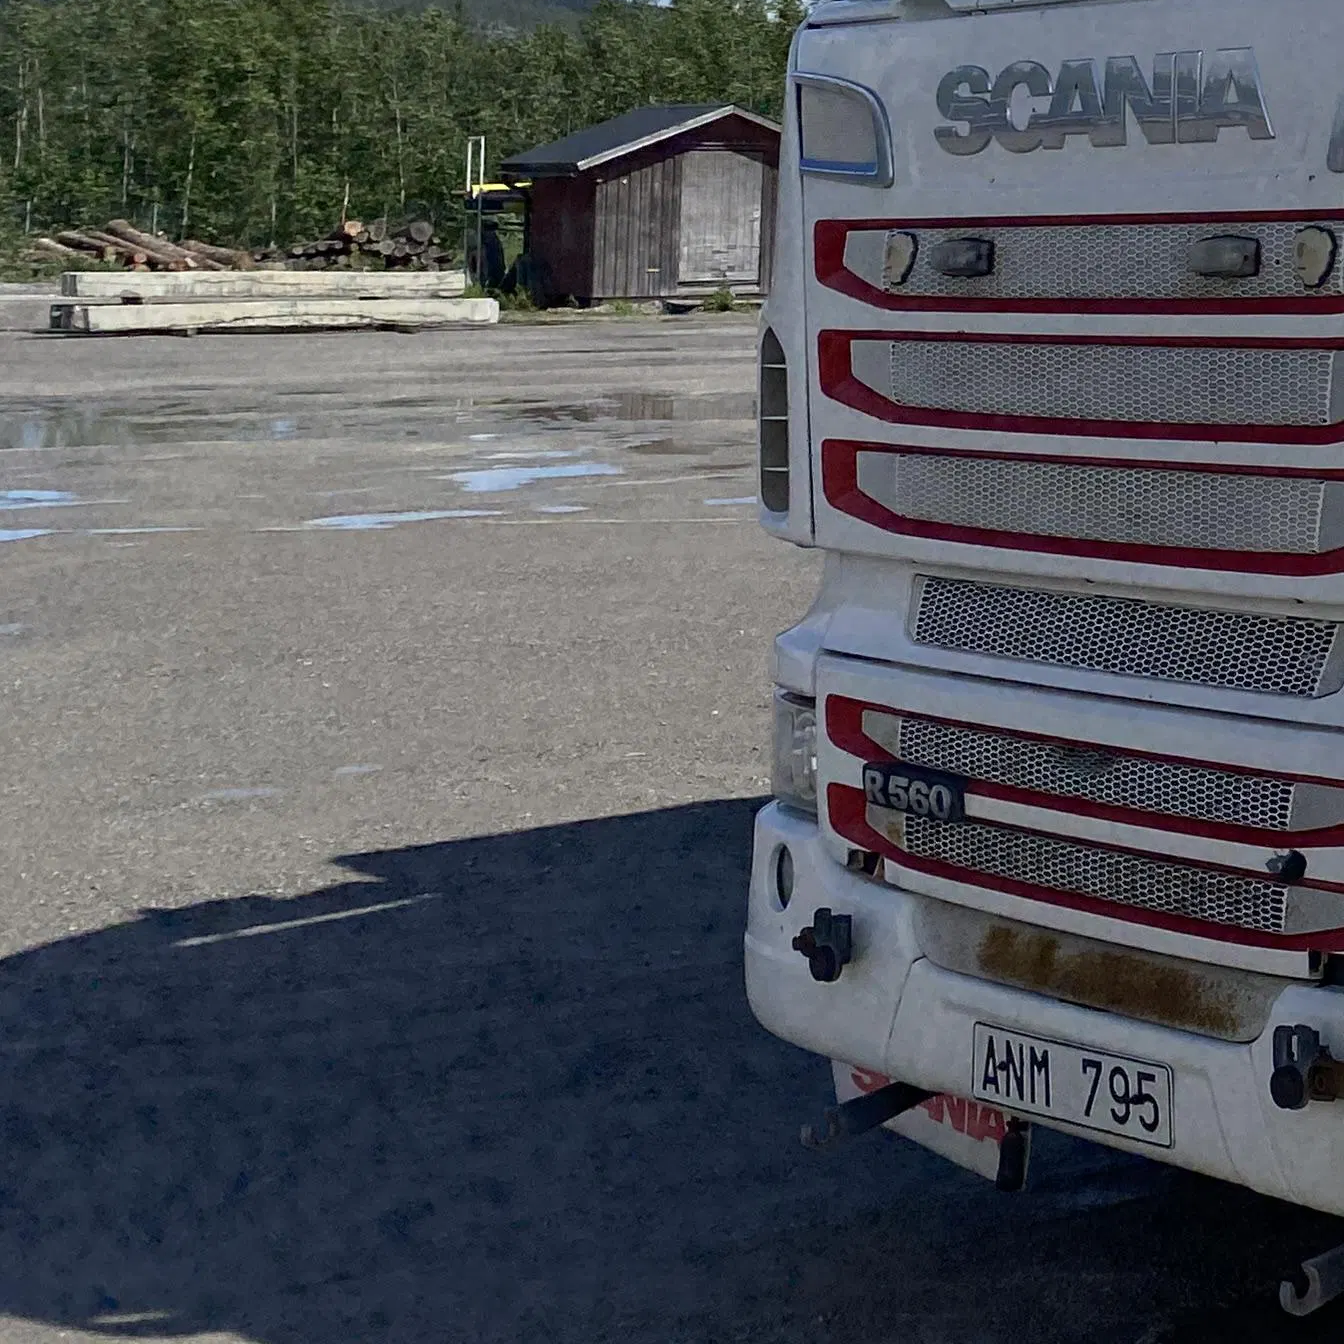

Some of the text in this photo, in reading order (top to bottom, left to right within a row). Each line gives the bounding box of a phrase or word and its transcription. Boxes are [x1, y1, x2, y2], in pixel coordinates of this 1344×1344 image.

[933, 46, 1276, 155] SCANIA
[982, 1035, 1160, 1132] ANM 795
